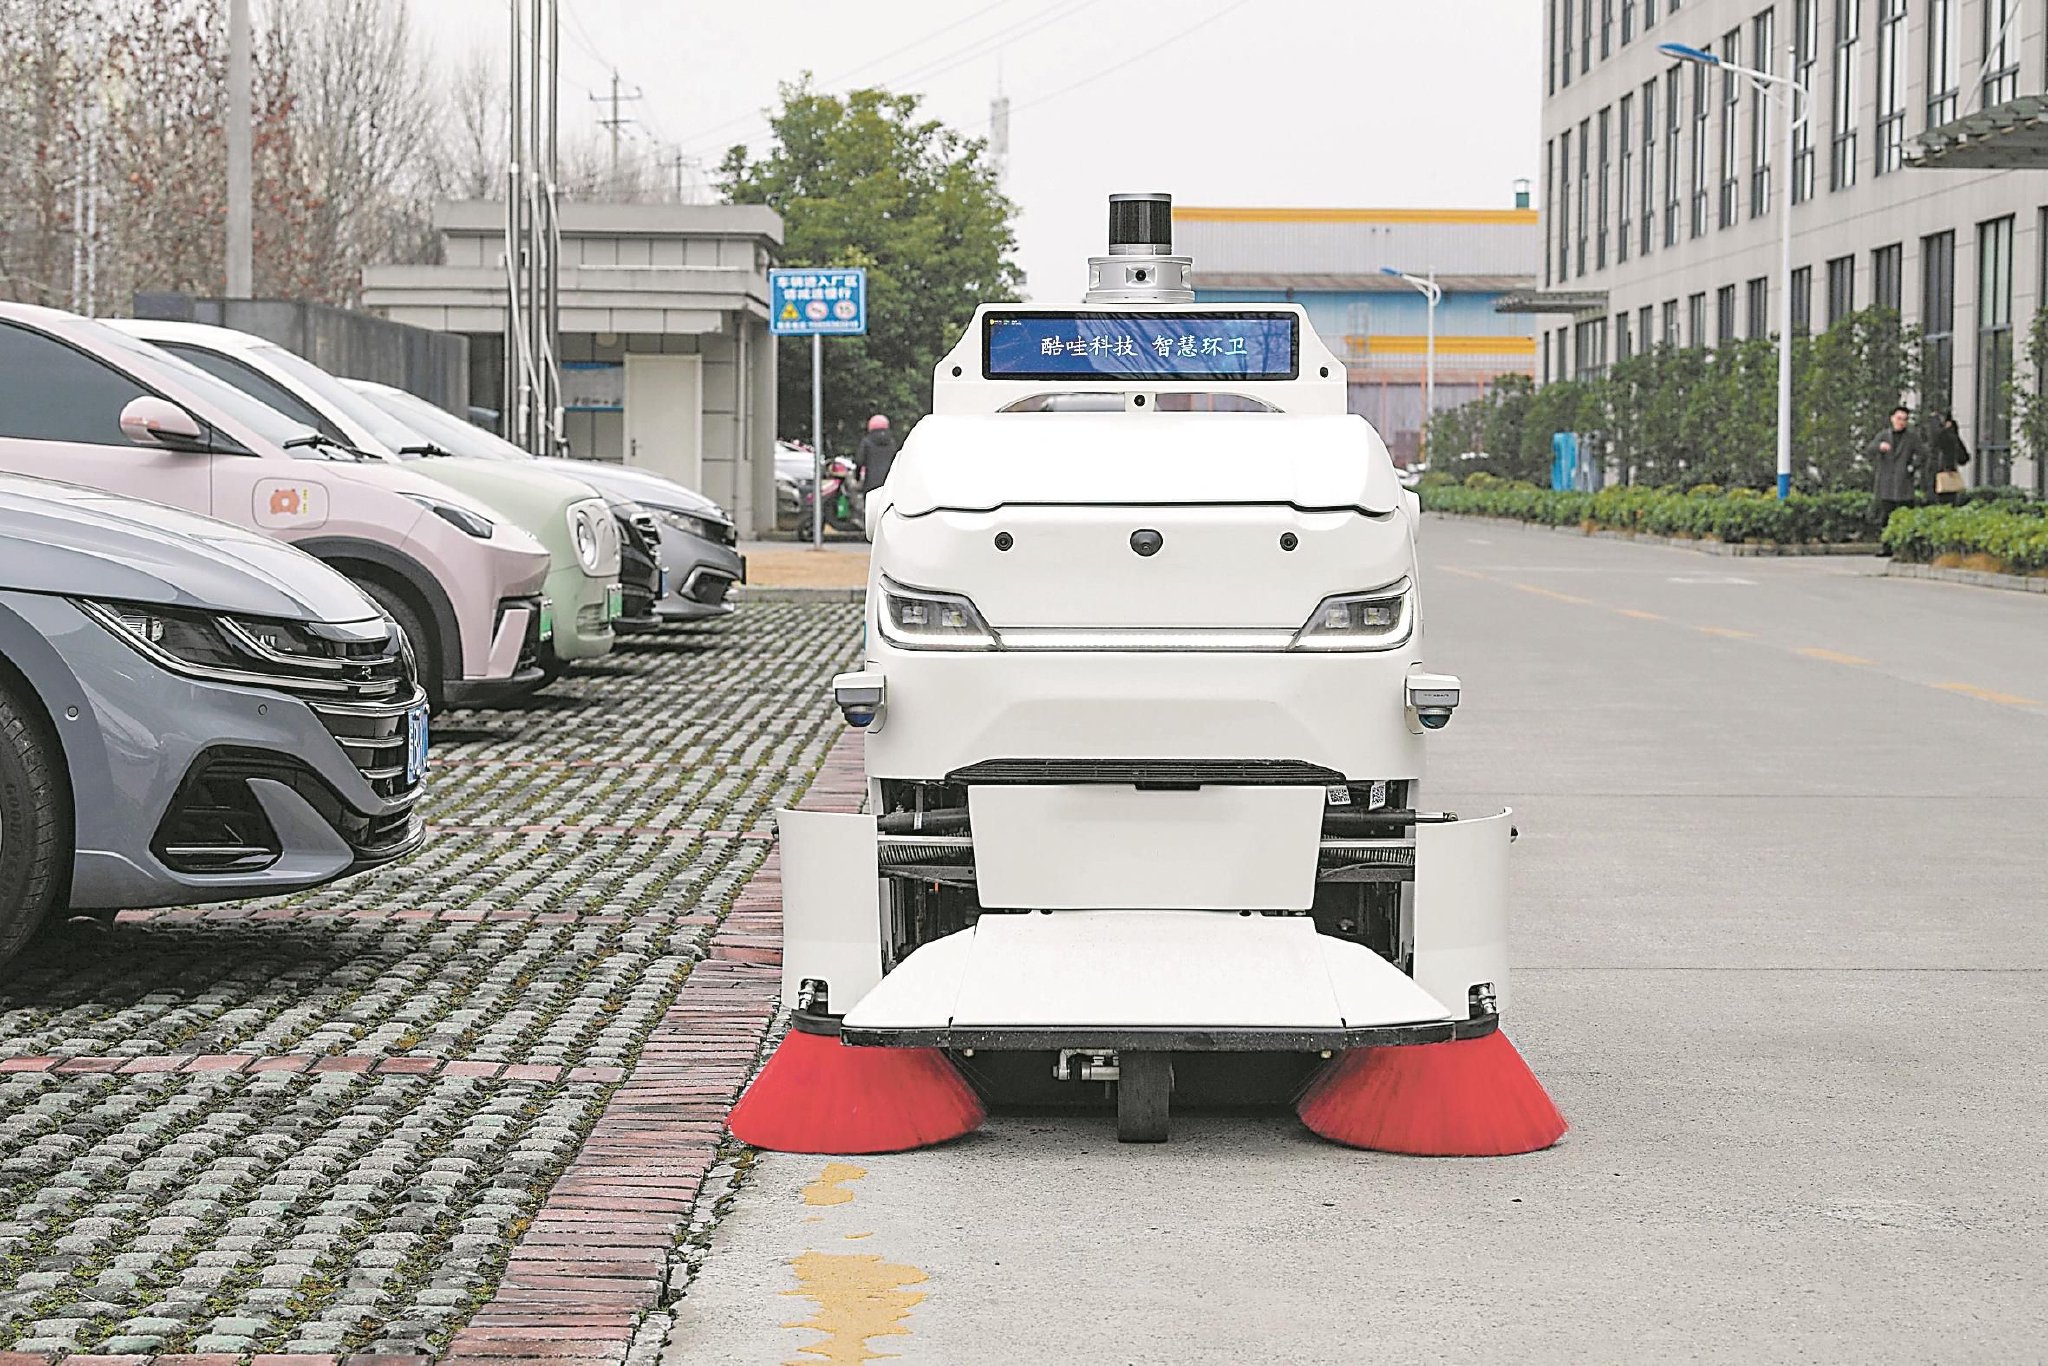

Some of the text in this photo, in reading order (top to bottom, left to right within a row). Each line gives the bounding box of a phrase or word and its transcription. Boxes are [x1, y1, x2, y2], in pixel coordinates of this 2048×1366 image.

[1041, 335, 1248, 357] 酷哇科技 智慧环卫
